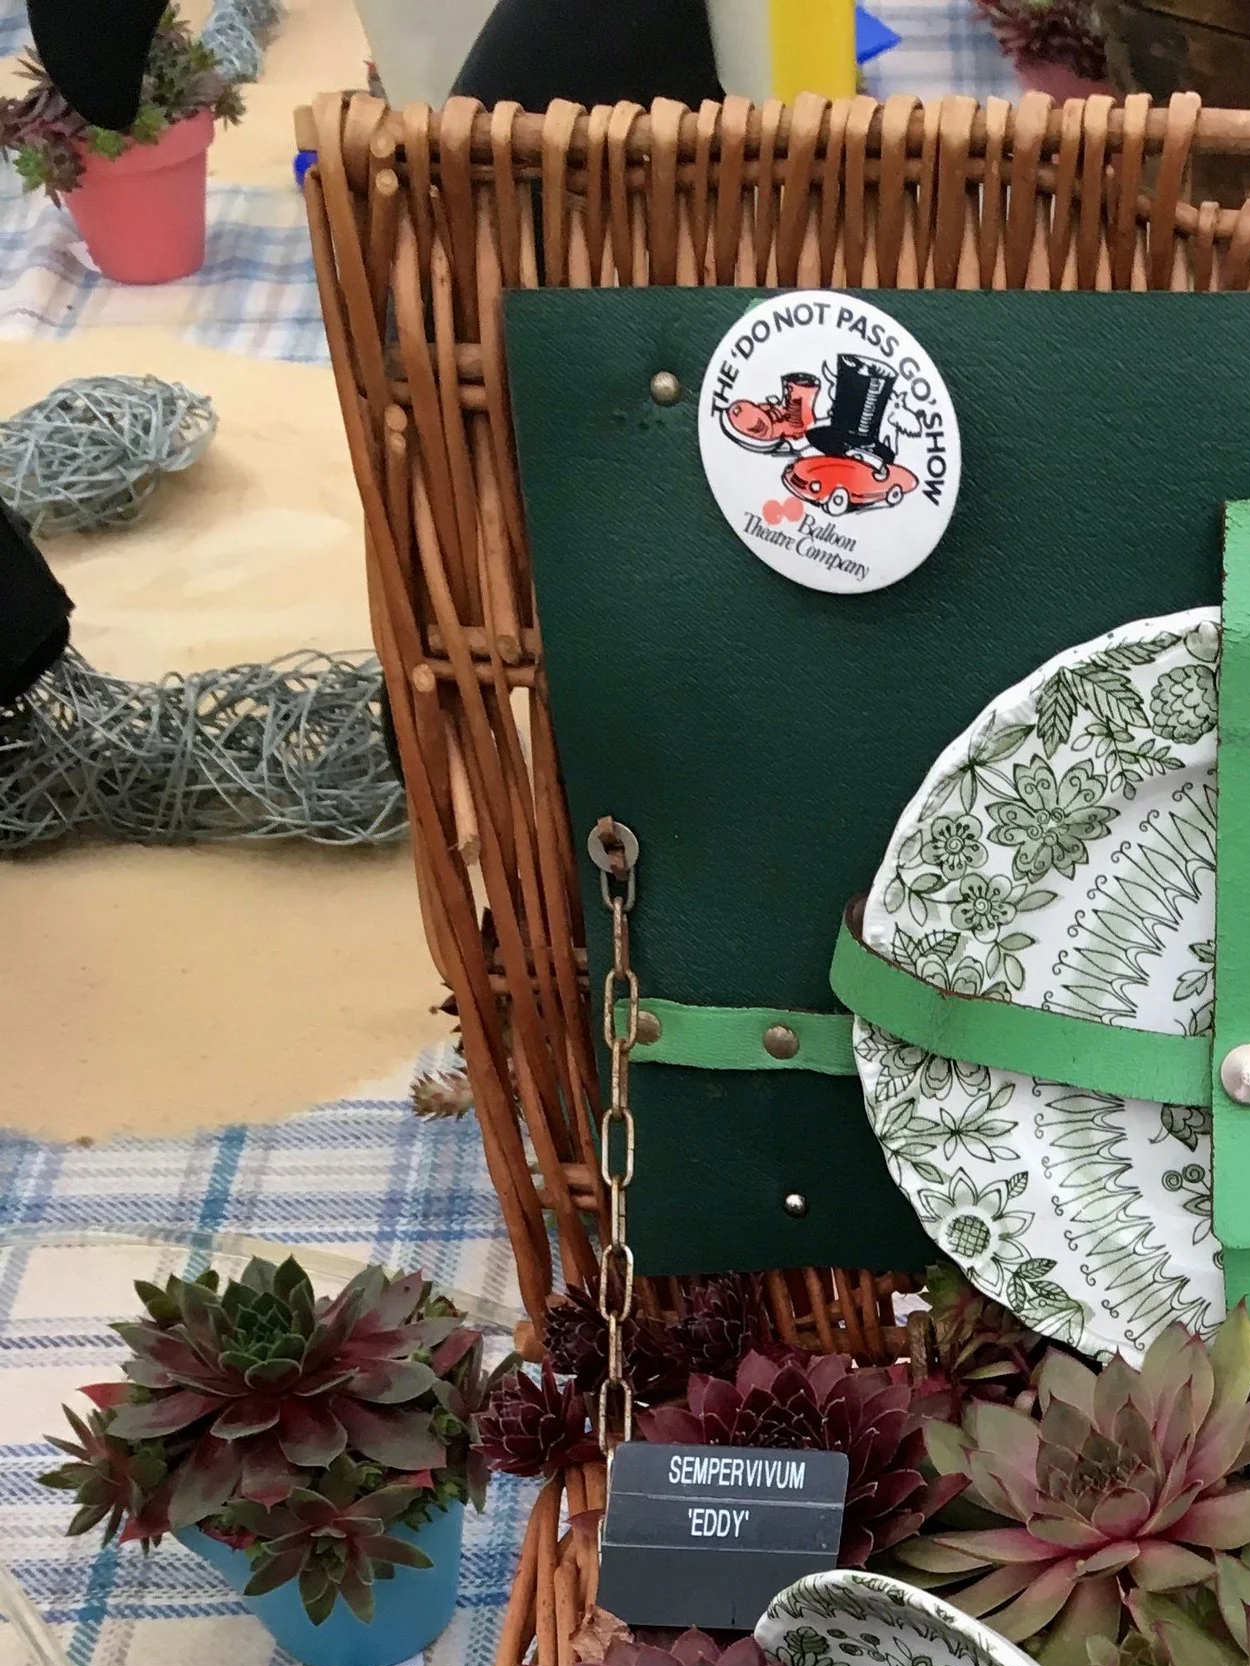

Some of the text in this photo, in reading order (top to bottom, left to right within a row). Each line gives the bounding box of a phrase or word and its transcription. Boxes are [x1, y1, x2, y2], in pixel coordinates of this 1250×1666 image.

[711, 361, 739, 418] THE
[773, 302, 831, 332] NOT
[836, 307, 899, 358] PASS
[923, 411, 947, 507] SHOW
[744, 511, 869, 581] Theatre Company
[797, 513, 857, 552] Balloon
[668, 1455, 806, 1490] SEMPERVIVUM
[687, 1508, 749, 1538] 'EDDY'
